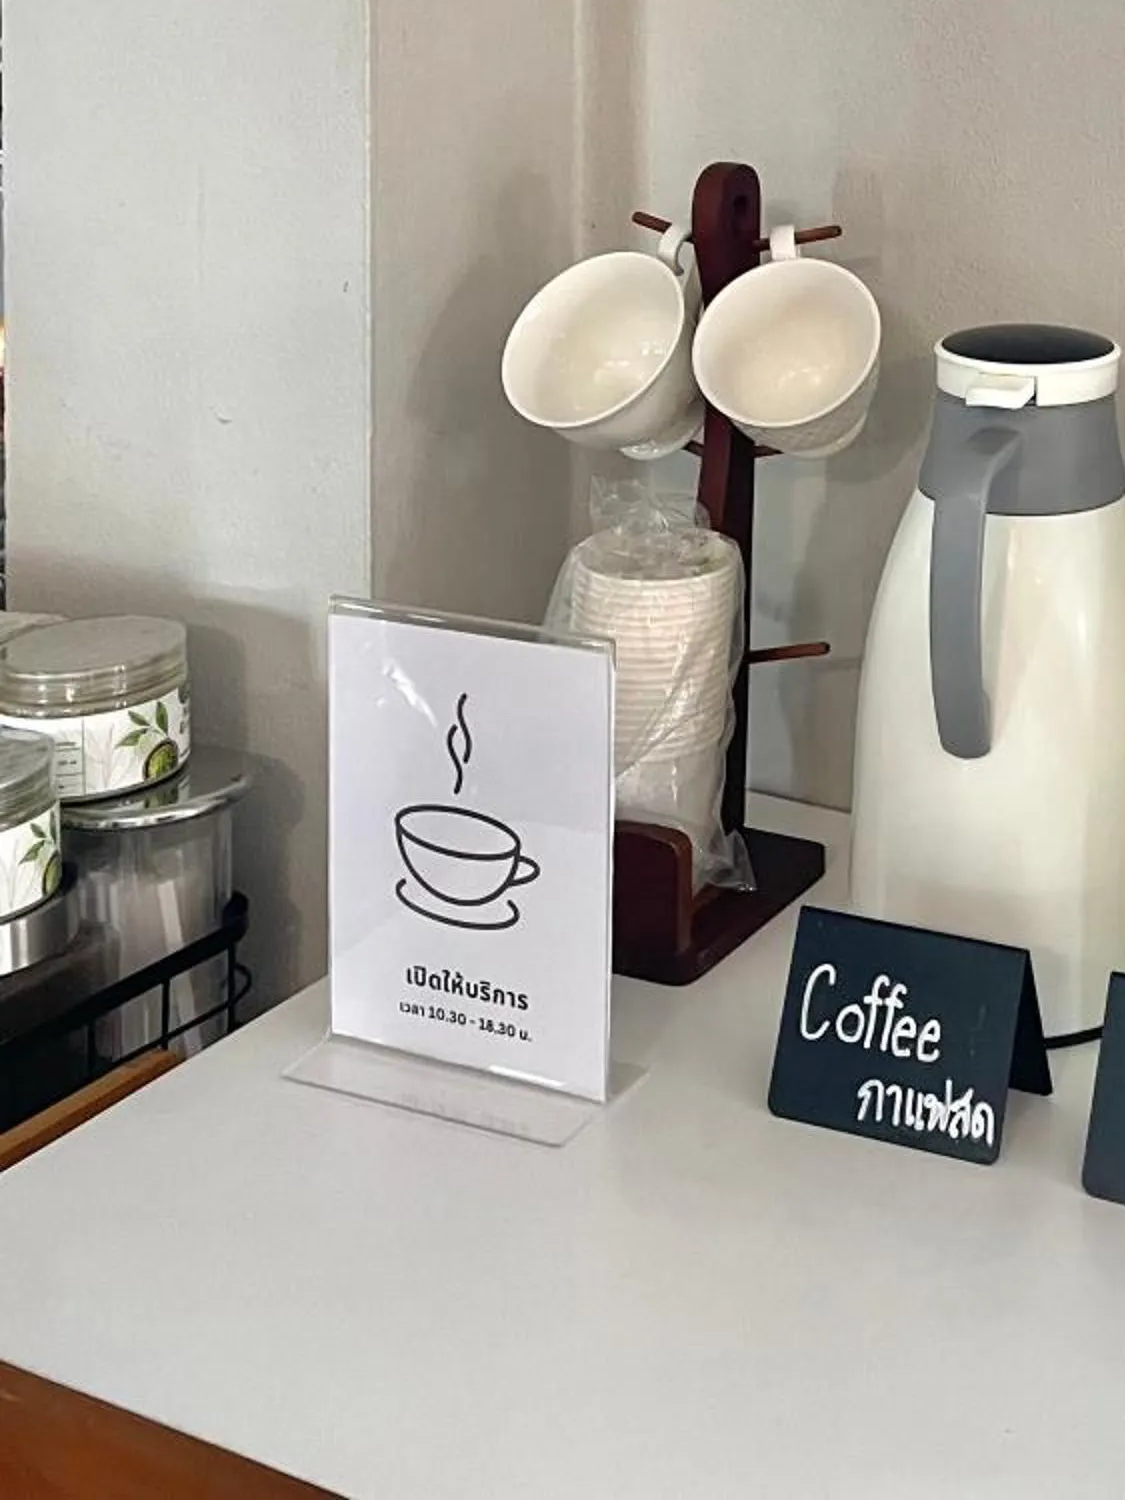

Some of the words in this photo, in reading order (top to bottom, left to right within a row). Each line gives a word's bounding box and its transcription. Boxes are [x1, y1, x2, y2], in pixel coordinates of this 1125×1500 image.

[405, 964, 529, 1011] เปิดให้บริการ
[800, 963, 942, 1064] Coffee
[399, 1001, 425, 1017] เวลา
[428, 1005, 467, 1026] 10.30
[479, 1017, 516, 1038] 18.30
[856, 1079, 995, 1149] กาแฟสด
